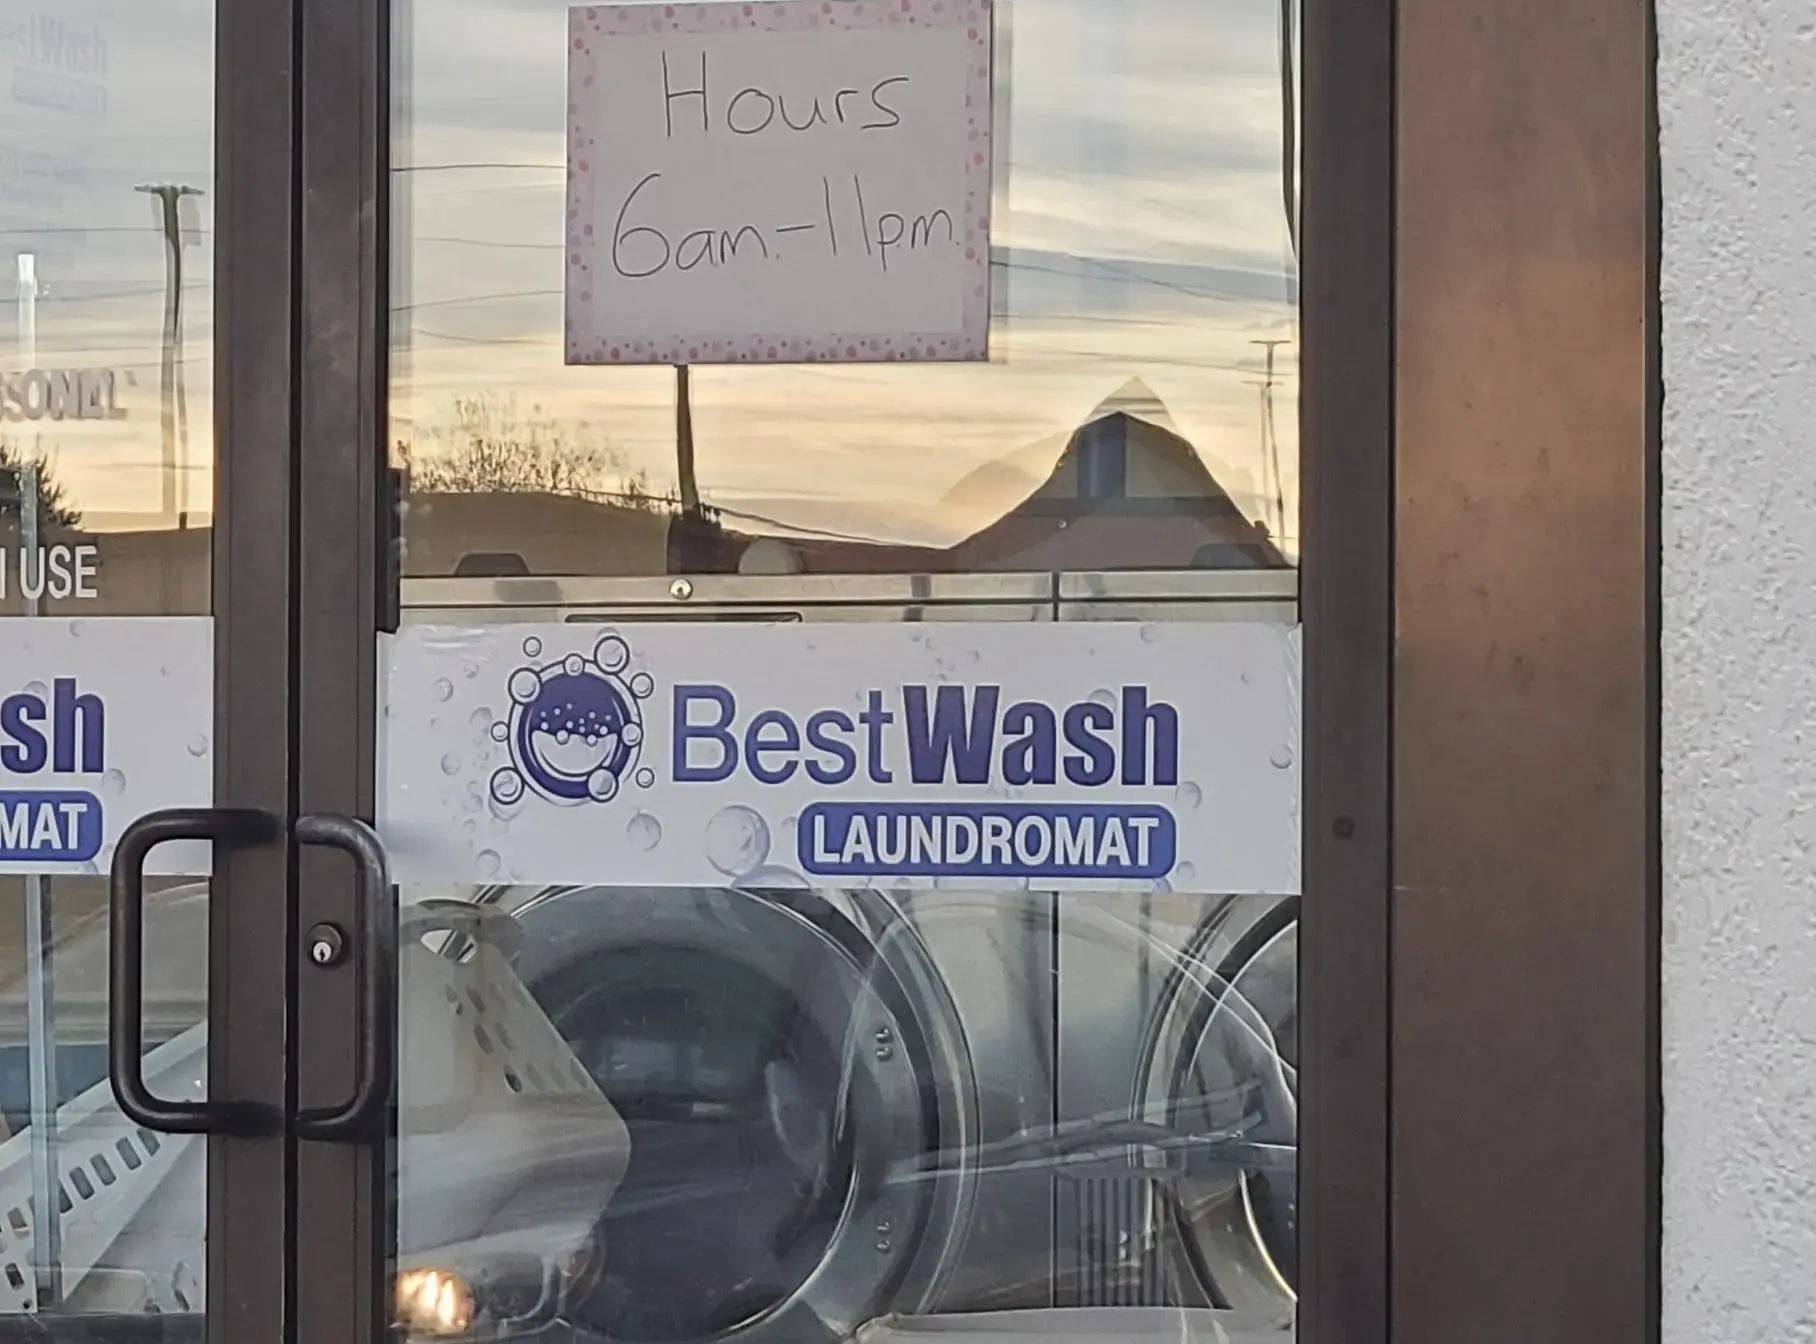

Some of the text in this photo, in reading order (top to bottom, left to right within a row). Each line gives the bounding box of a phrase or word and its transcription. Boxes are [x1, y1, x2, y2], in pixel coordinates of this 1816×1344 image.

[661, 51, 909, 137] Hours
[20, 545, 97, 599] USE
[0, 677, 104, 774] sh
[672, 684, 1178, 787] BestWash
[813, 814, 1160, 867] LAUNDROMAT
